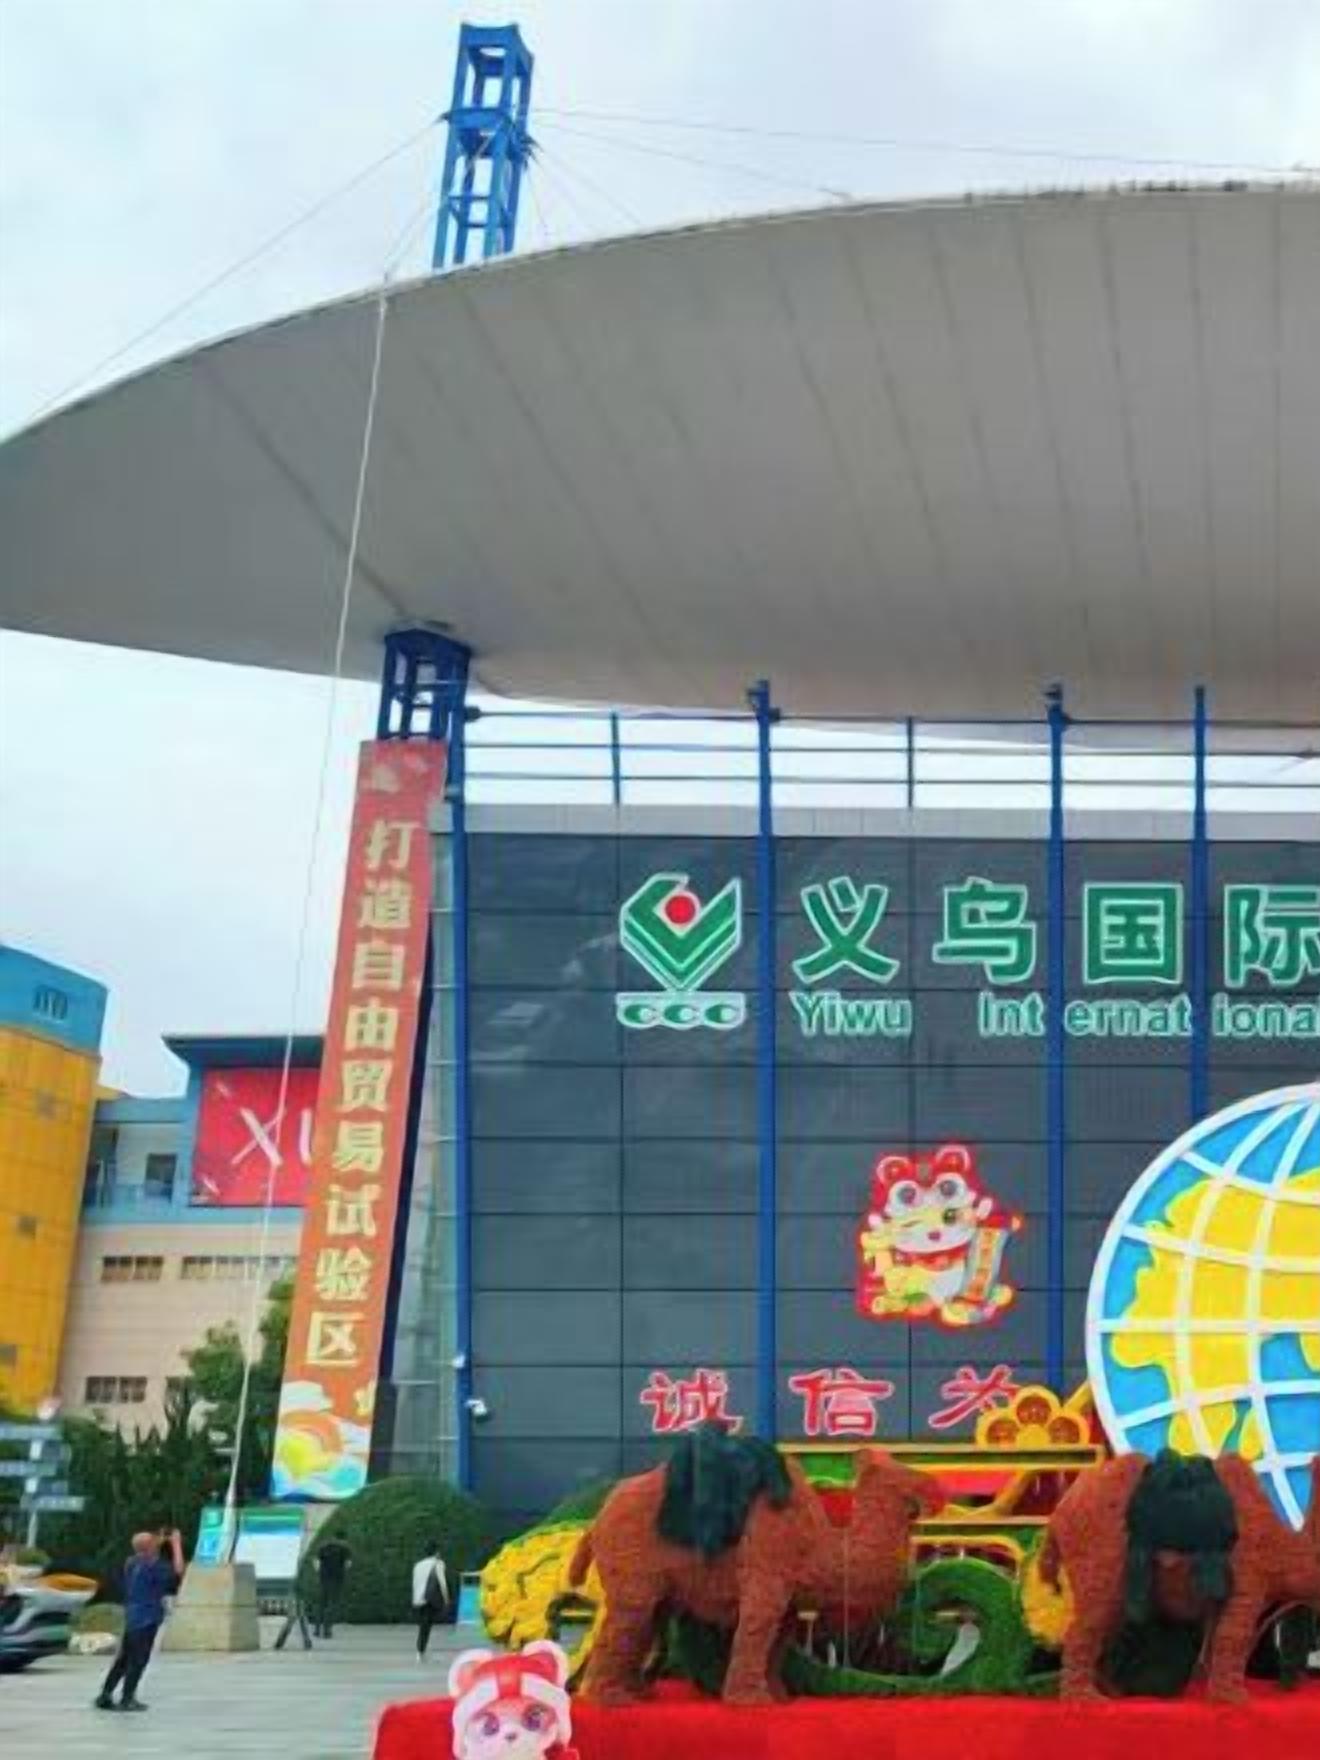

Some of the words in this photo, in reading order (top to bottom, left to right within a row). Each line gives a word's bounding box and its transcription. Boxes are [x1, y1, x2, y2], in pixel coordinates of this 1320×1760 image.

[305, 819, 420, 1367] 打造自由贸易试验区
[790, 990, 913, 1037] Yiwu
